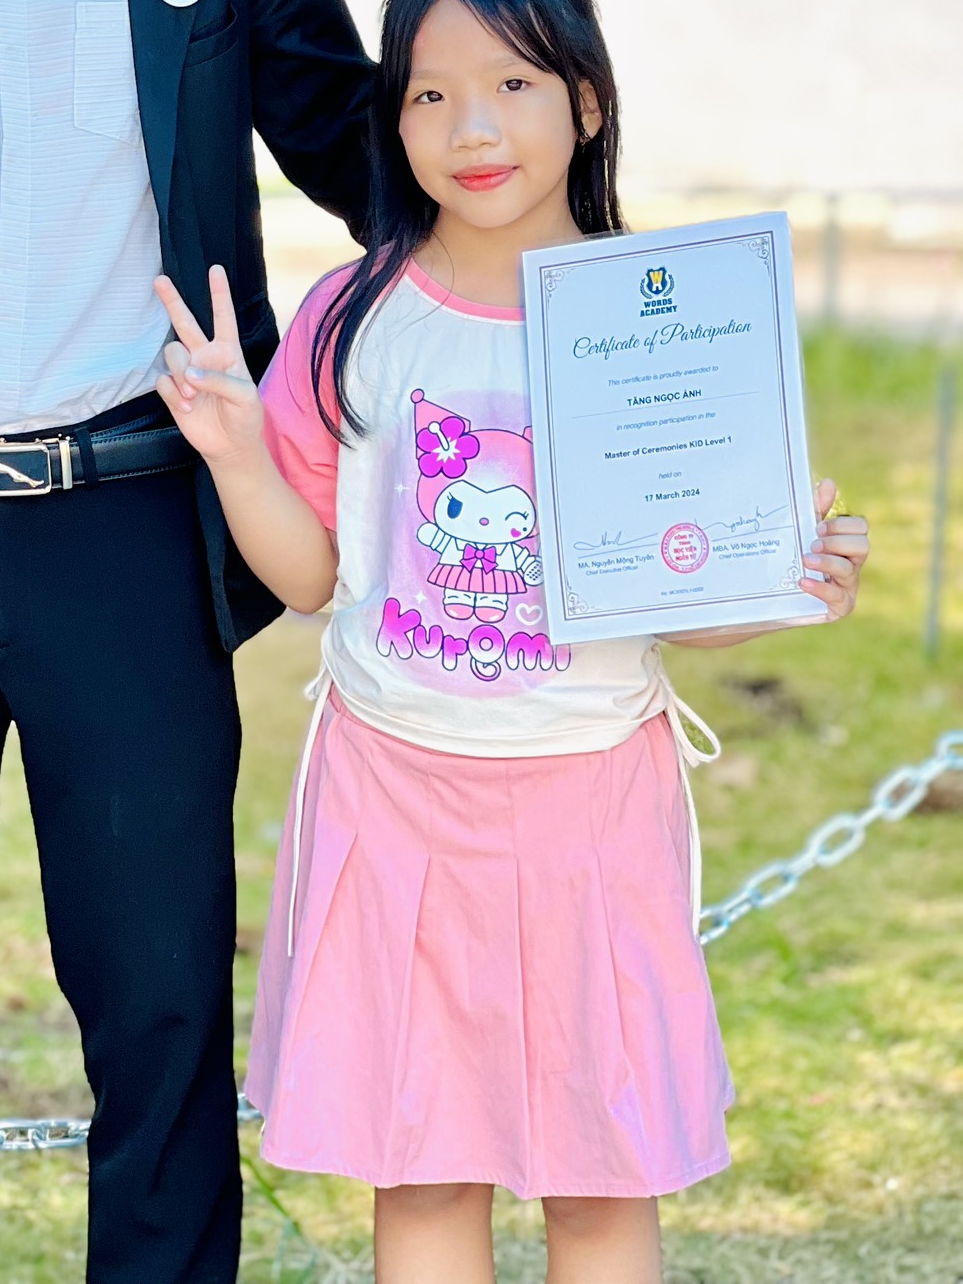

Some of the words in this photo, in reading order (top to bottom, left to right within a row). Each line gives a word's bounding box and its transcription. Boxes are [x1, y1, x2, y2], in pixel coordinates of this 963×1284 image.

[643, 297, 673, 309] WORDS
[639, 304, 678, 318] ACADEMY
[573, 333, 640, 361] Certificate
[643, 329, 659, 354] of
[660, 318, 753, 345] Participation
[608, 378, 621, 387] This
[621, 375, 652, 384] certificate
[652, 373, 658, 381] is
[659, 370, 683, 380] proudly
[683, 365, 711, 376] awarded
[653, 391, 681, 403] NGỌC
[623, 419, 658, 430] recognition
[658, 414, 697, 426] participation
[604, 450, 631, 460] Master
[632, 448, 640, 456] of
[641, 442, 688, 455] Ceremonies
[689, 439, 704, 448] KID
[704, 436, 726, 446] Level
[727, 435, 732, 443] 1
[658, 471, 673, 480] held
[645, 494, 654, 502] 17
[655, 491, 680, 501] March
[681, 488, 700, 498] 2024
